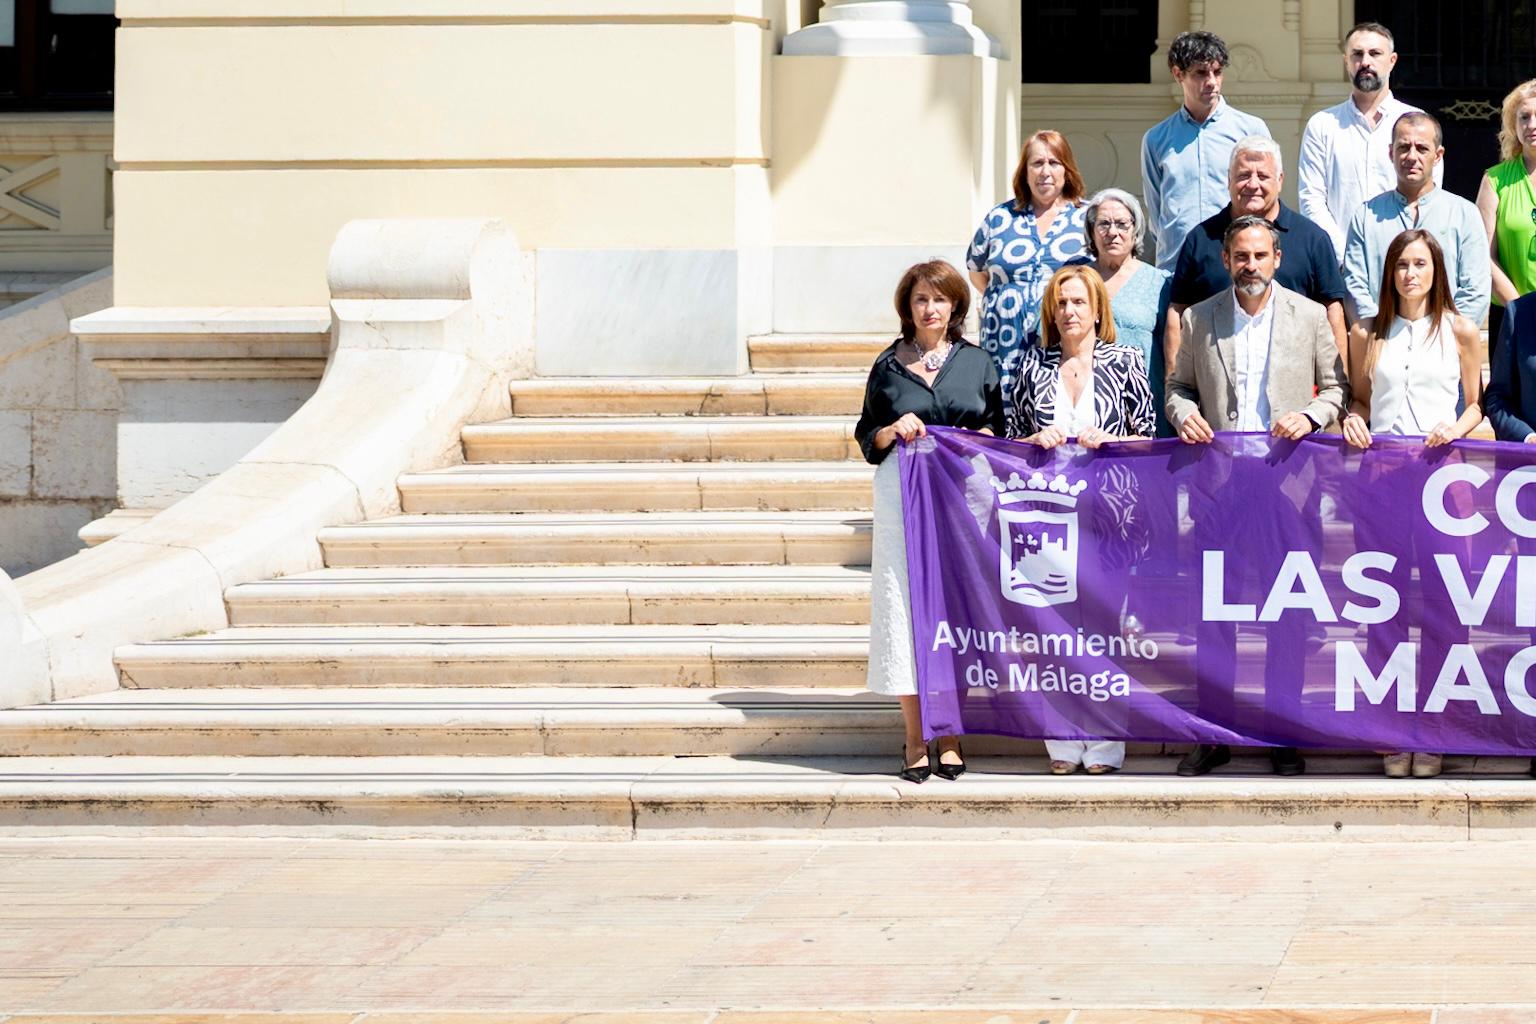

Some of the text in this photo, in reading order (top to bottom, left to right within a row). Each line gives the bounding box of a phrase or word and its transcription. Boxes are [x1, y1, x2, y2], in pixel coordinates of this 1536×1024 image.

[1202, 550, 1402, 624] LAS
[932, 621, 1159, 661] Ayuntamiento
[966, 660, 1130, 702] de Málaga
